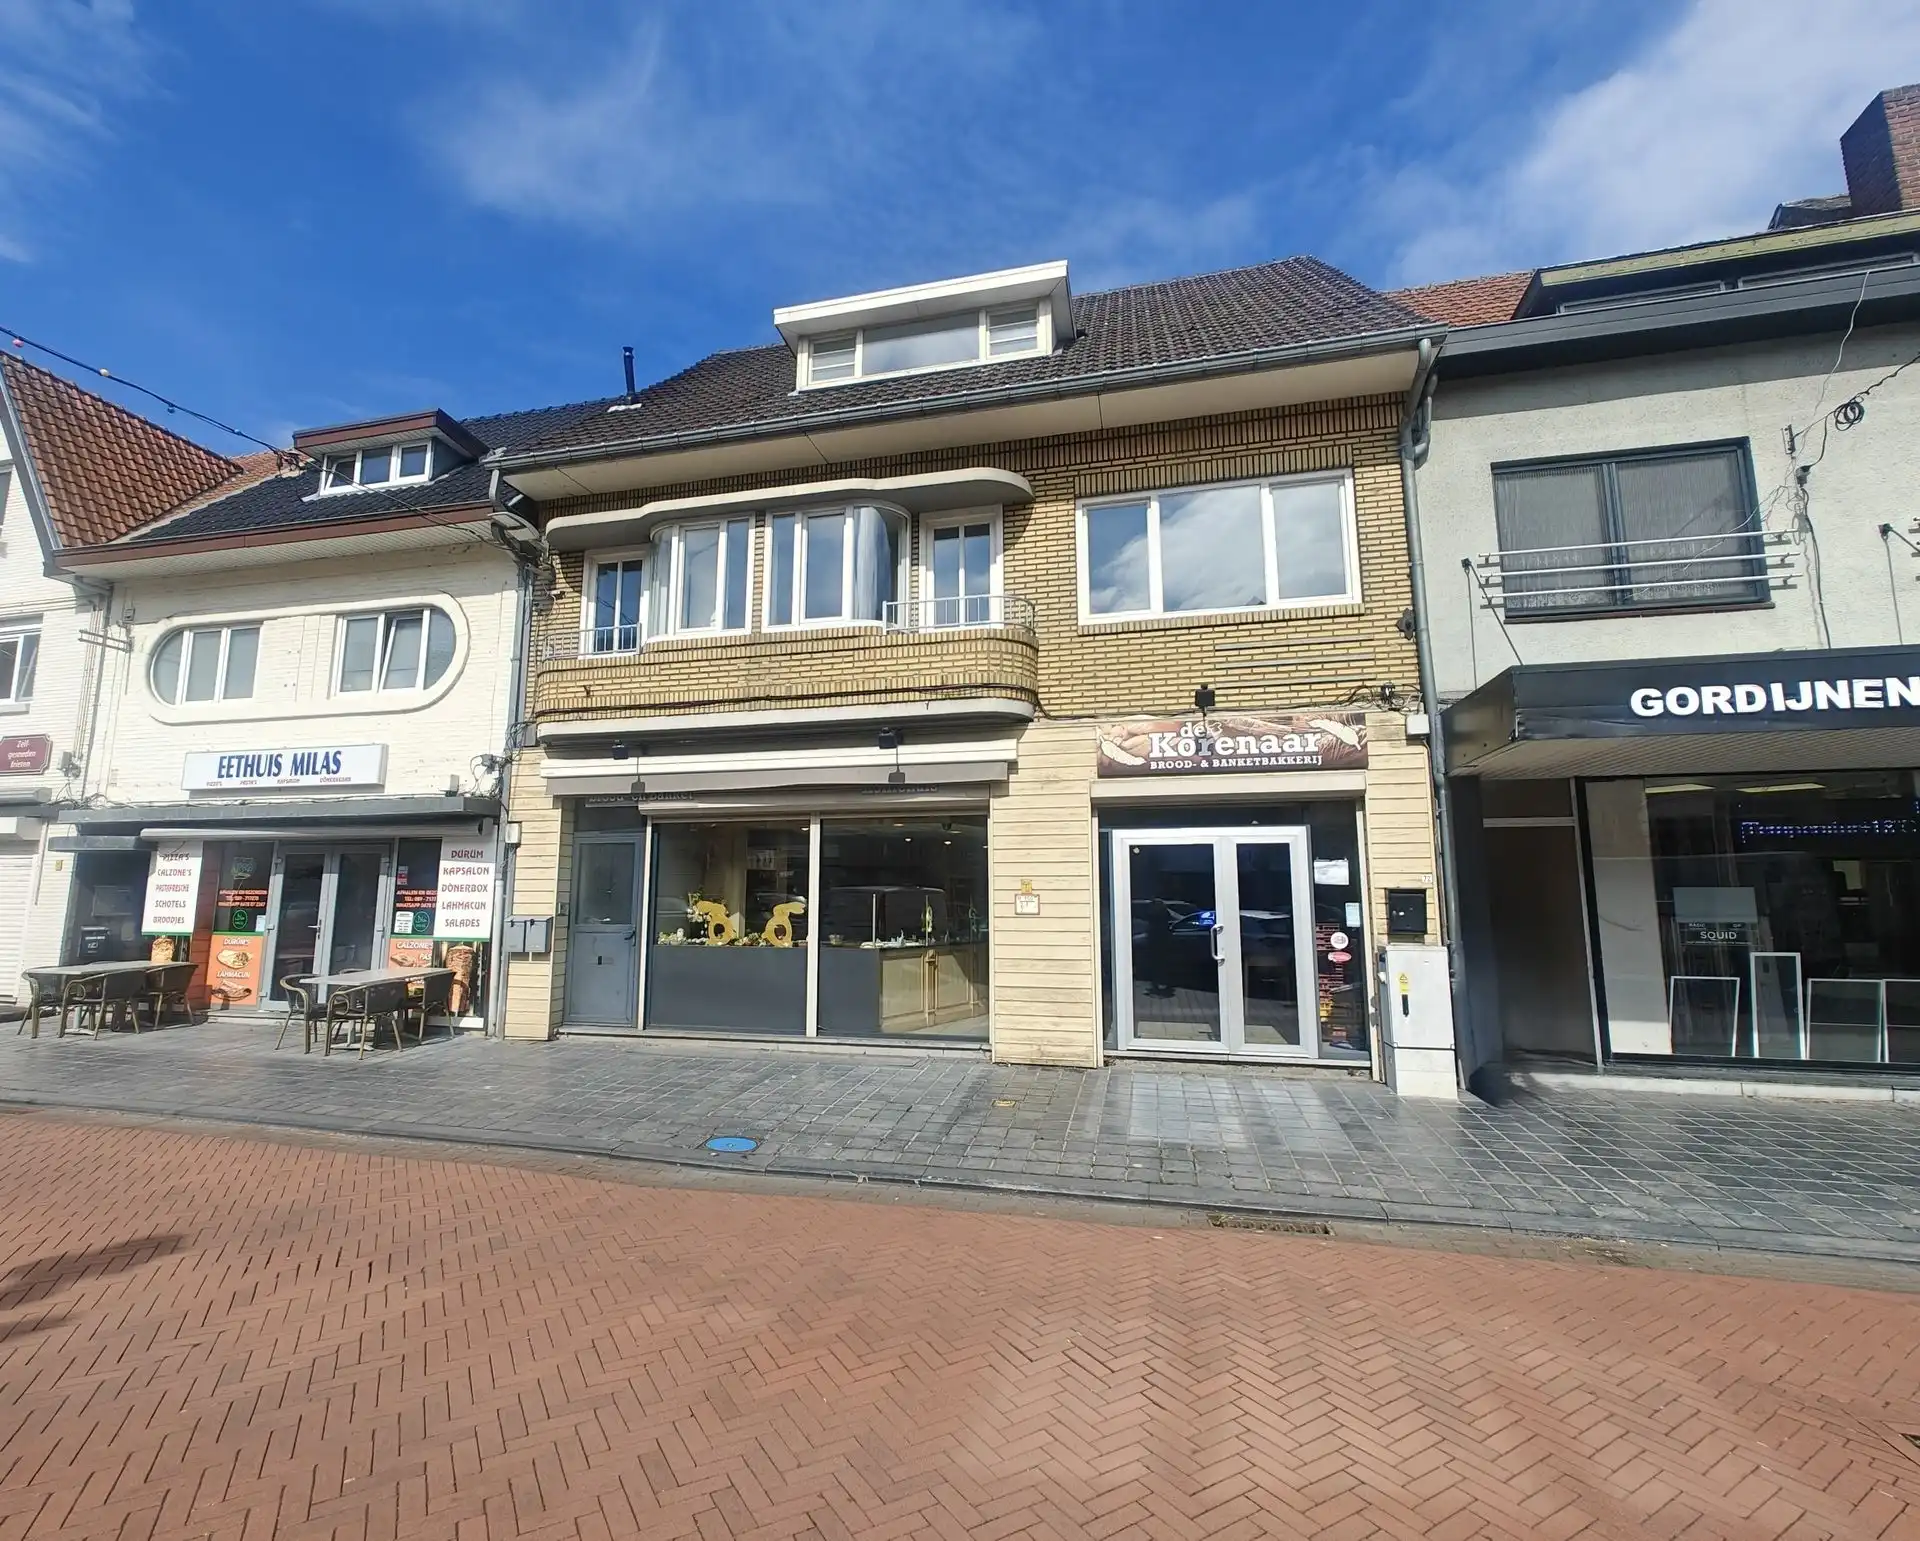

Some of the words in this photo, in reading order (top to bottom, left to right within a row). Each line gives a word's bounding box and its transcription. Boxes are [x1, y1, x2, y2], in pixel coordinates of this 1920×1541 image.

[1630, 676, 1920, 717] GORDIJNEN
[1181, 722, 1206, 738] de
[1149, 731, 1322, 758] Korenaar
[217, 754, 283, 779] EETHUIS
[290, 750, 343, 776] MILAS
[1150, 759, 1197, 769] BROOD-
[1200, 759, 1209, 768] &
[1212, 755, 1323, 768] BANKETBAKKERIJ
[443, 866, 489, 876] KAPSALON
[154, 900, 186, 909] SCHOTELS
[441, 901, 486, 910] LAHMACUN
[152, 916, 185, 925] BROODJES
[445, 918, 480, 927] SALADES
[1700, 931, 1737, 941] SQUID
